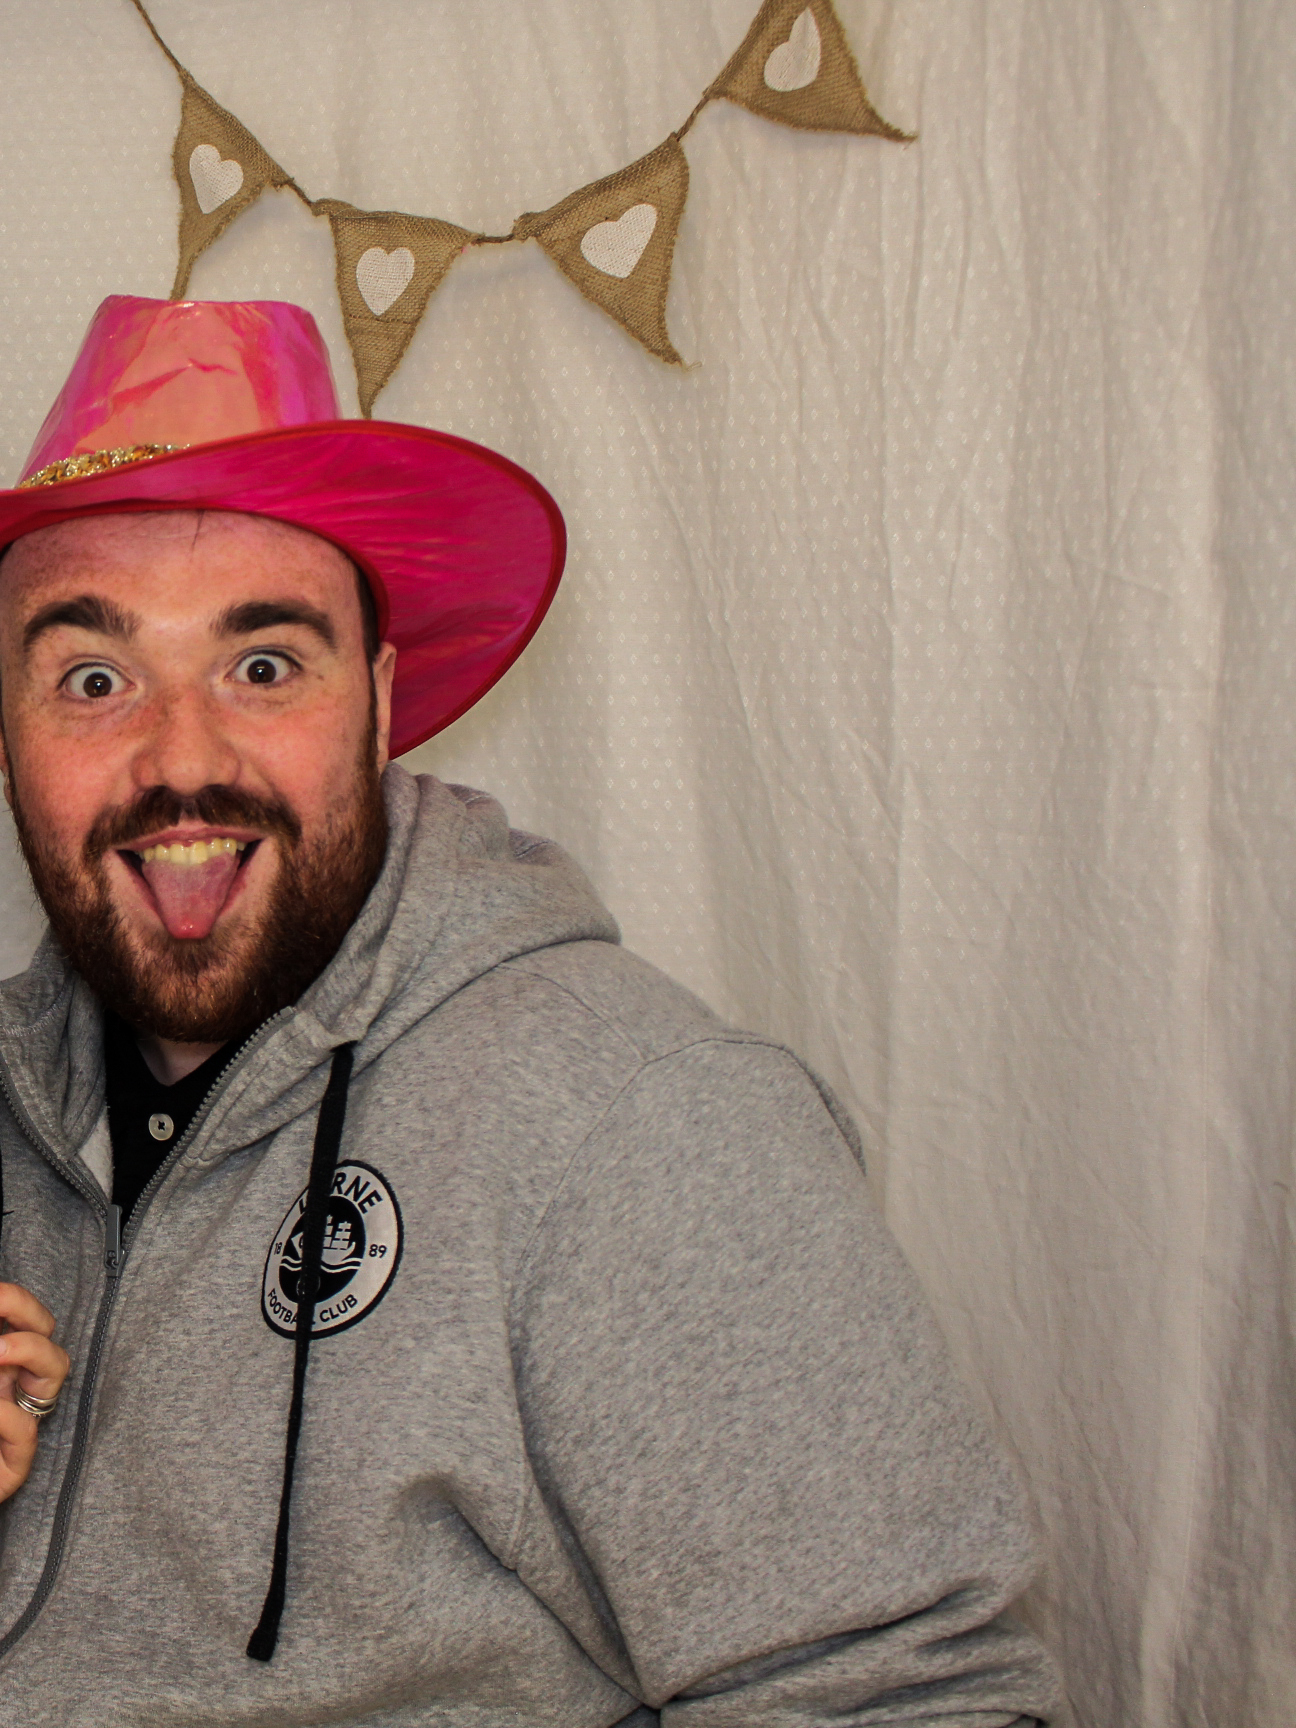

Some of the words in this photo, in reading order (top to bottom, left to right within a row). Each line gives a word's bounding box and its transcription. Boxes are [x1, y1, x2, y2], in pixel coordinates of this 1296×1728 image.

[299, 1172, 383, 1214] LRNE
[274, 1241, 283, 1255] 18
[368, 1244, 387, 1259] 89
[319, 1294, 358, 1322] CLUB
